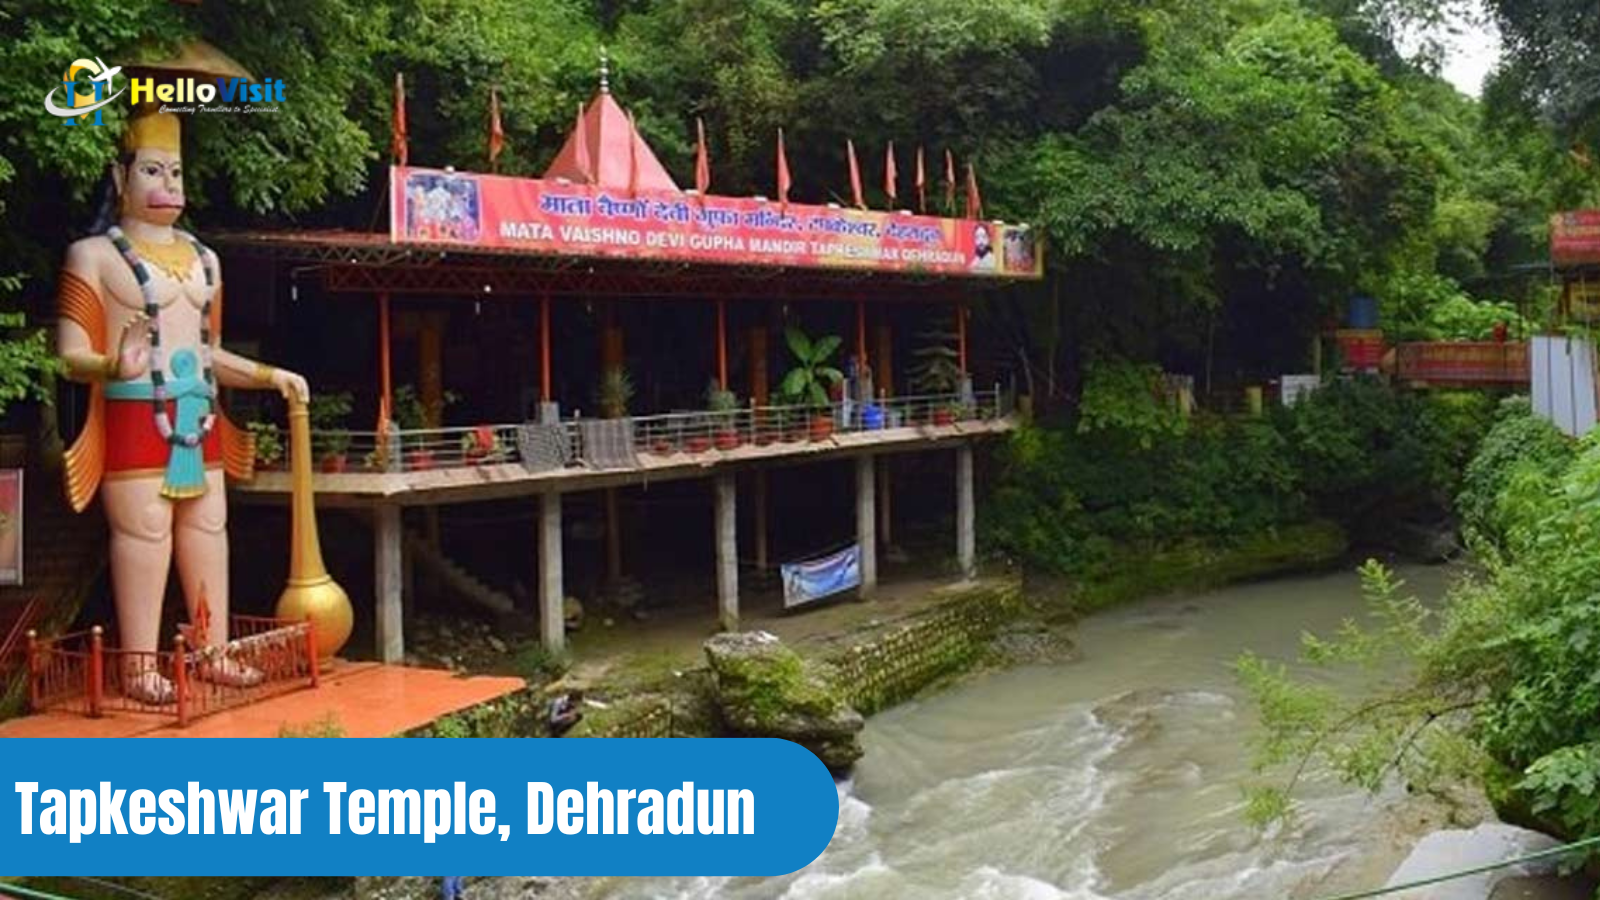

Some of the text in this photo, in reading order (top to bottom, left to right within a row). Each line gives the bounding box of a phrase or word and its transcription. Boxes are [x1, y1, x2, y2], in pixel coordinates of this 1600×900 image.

[541, 193, 592, 216] माता
[500, 222, 554, 240] MATA
[559, 225, 641, 246] VAISHNO
[646, 231, 685, 248] DEVI
[689, 233, 745, 251] GUPHA
[749, 237, 807, 254] MANDIR
